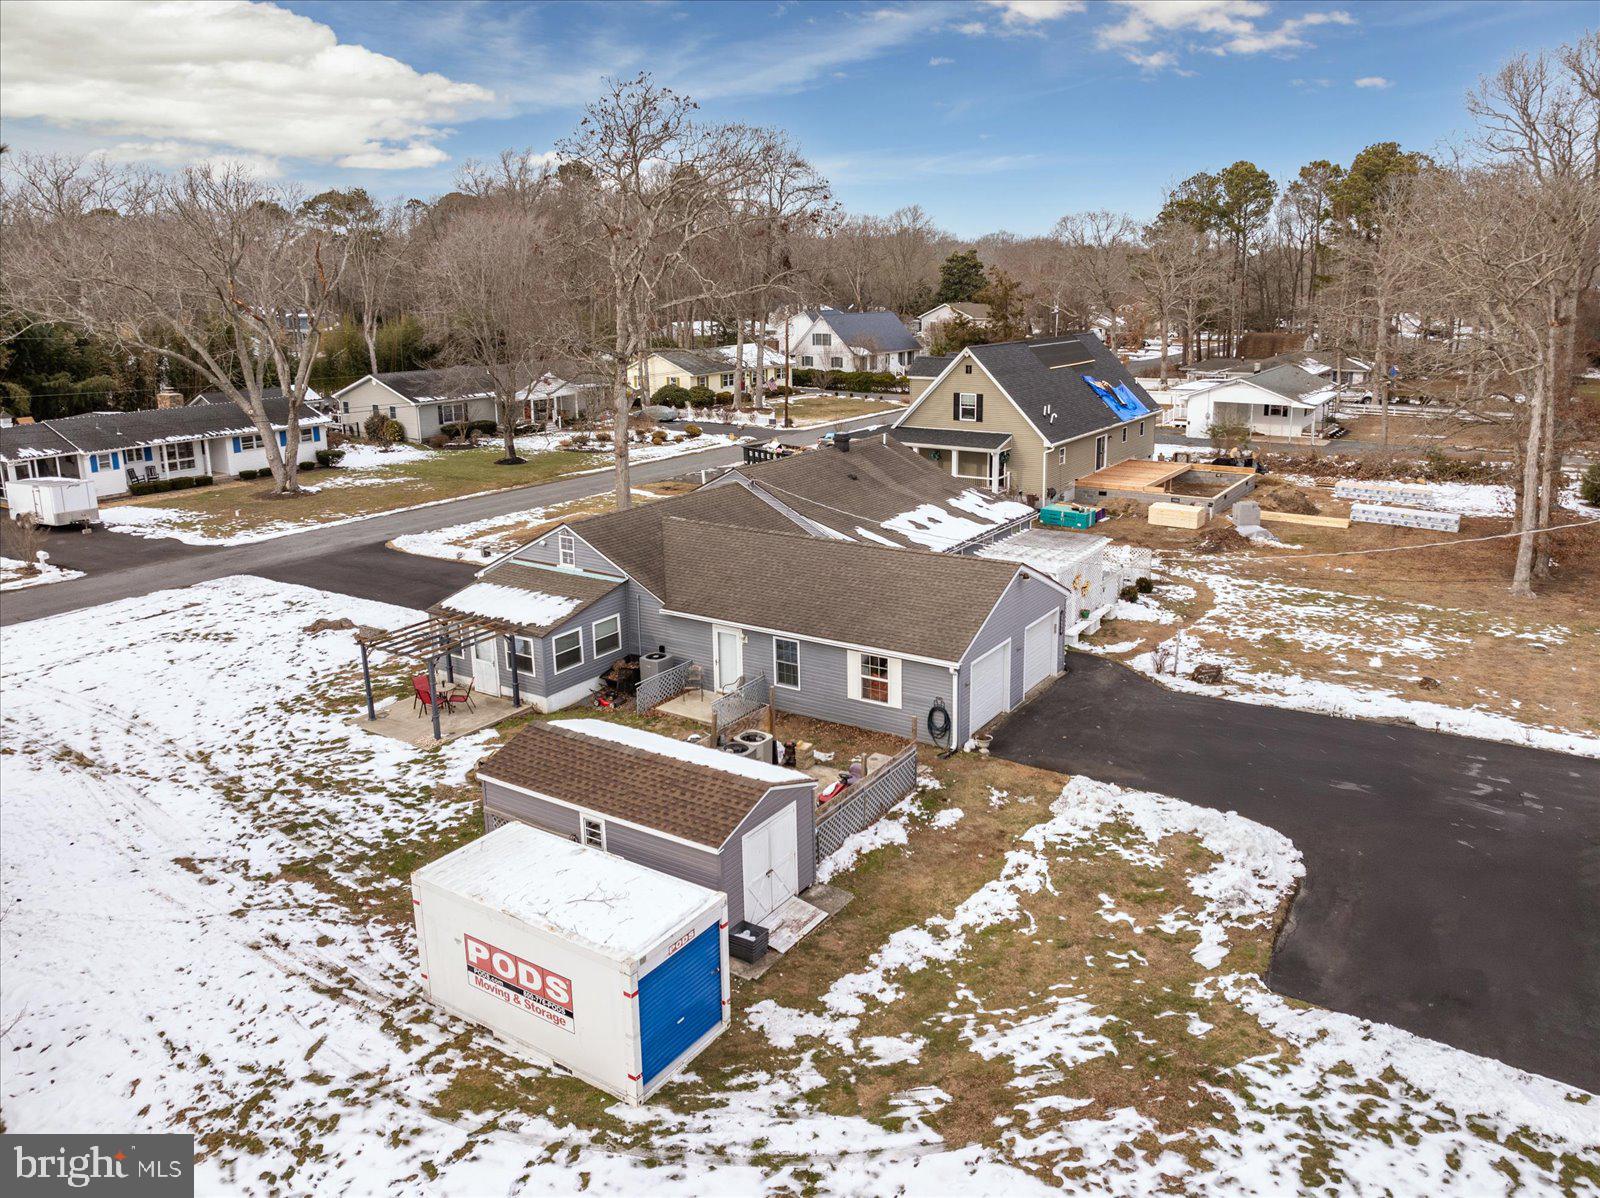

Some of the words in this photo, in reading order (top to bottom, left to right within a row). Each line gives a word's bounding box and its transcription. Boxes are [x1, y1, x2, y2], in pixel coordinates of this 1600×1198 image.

[668, 929, 696, 956] PODS
[467, 938, 570, 1004] PODS
[474, 975, 511, 1002] Moving
[513, 994, 522, 1005] &
[524, 998, 567, 1026] Storage
